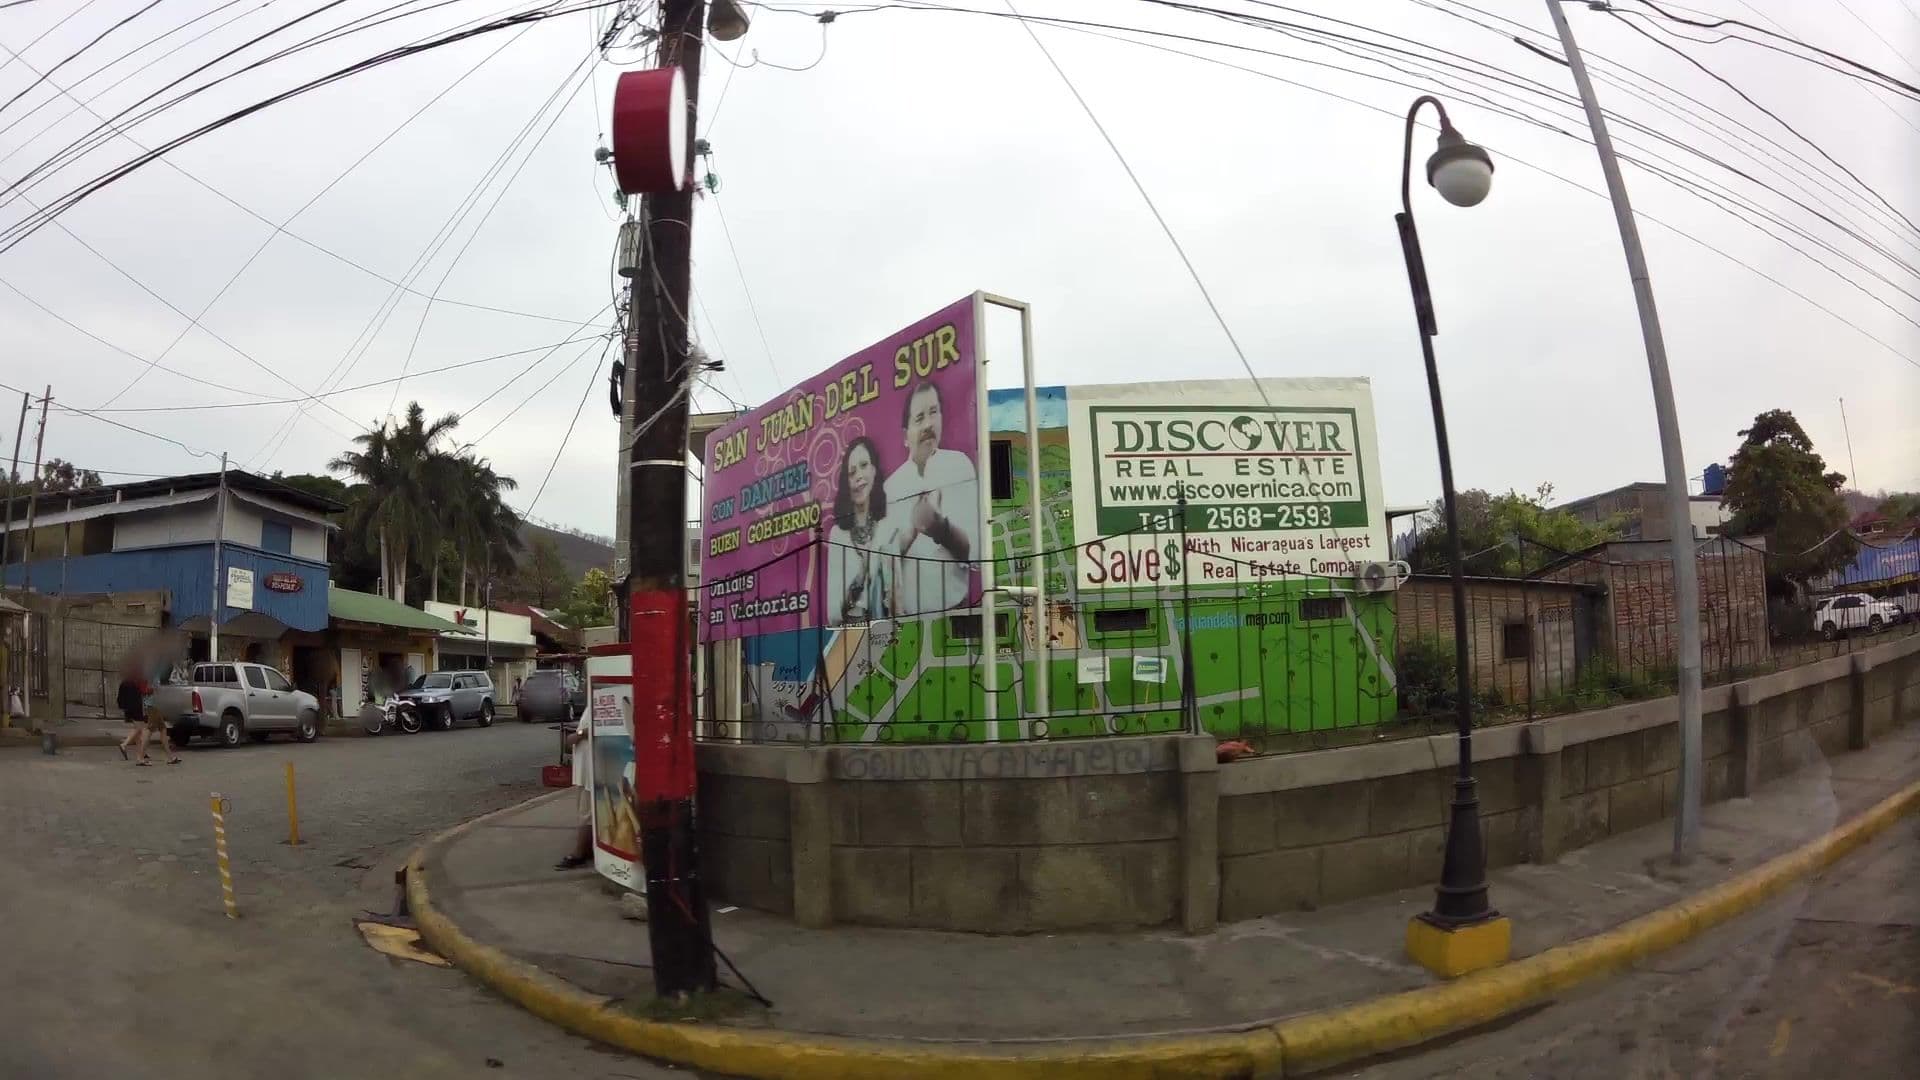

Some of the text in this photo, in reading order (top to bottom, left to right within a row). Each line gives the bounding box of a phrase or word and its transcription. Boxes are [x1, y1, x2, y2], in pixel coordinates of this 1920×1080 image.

[712, 323, 961, 474] SAN JUAN DEL SUR
[1112, 416, 1346, 452] DISCOVER
[1116, 457, 1345, 478] REAL ESTATE
[711, 462, 812, 522] CON DANIEL
[1110, 478, 1353, 502] www.discovernica.com
[709, 501, 822, 558] BUEN GOBIERNO
[1206, 505, 1332, 530] 2568-2593
[1184, 537, 1221, 554] With
[1231, 537, 1314, 555] Nicaragua's
[1203, 557, 1372, 579] Real Estate Compa
[709, 610, 725, 624] en
